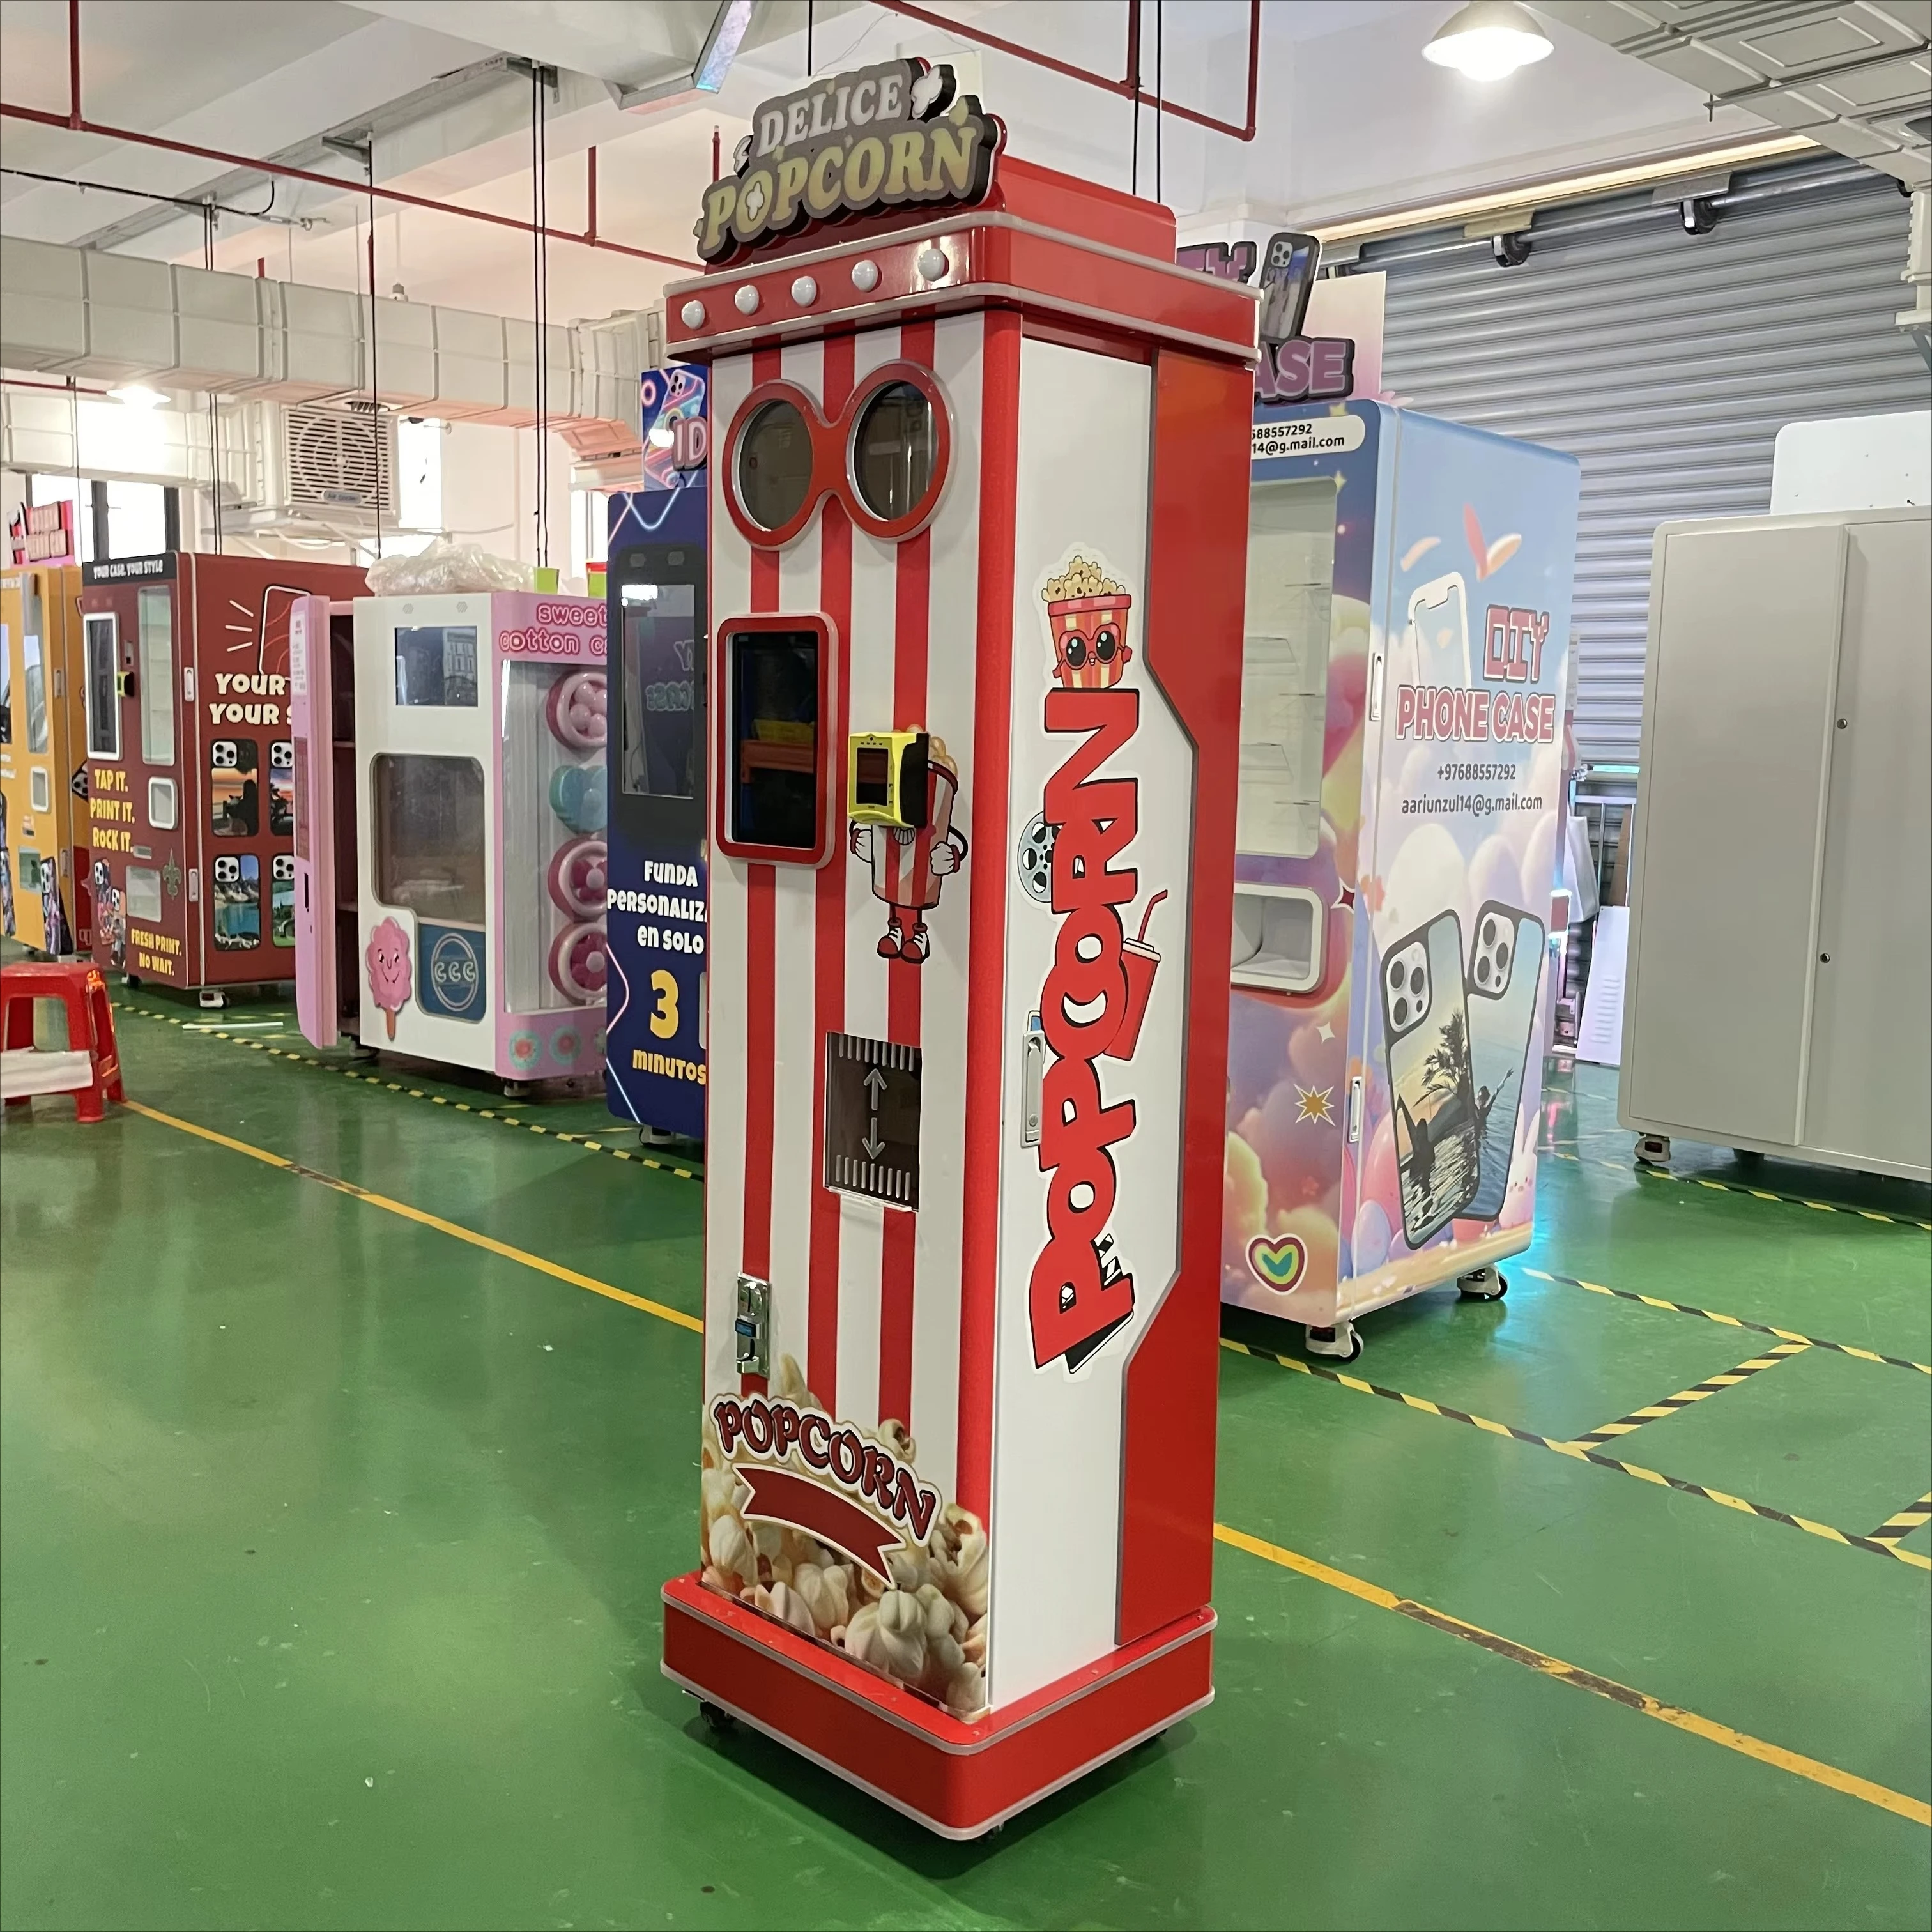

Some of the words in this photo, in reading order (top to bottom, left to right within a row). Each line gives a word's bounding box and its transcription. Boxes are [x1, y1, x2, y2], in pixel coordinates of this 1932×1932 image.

[756, 74, 903, 157] DELICE
[702, 126, 977, 250] POPCORN
[536, 603, 607, 627] sweet
[499, 627, 580, 656] cotton
[1483, 604, 1550, 684] DIY
[215, 673, 286, 695] YOUR
[208, 703, 280, 725] YOUR
[1395, 685, 1491, 742] PHONE
[1491, 691, 1556, 744] CASE
[94, 769, 114, 791] TAP
[116, 770, 128, 792] IT.
[1438, 763, 1516, 781] +97688557292
[90, 797, 120, 821] PRINT
[122, 802, 135, 824] IT.
[1402, 792, 1542, 817] aariunzul14@g.mail.com
[93, 827, 119, 851] ROCK
[121, 831, 133, 853] IT.
[644, 860, 698, 887] FUNDA
[607, 889, 707, 923] PERSONALIZ
[131, 928, 154, 949] FRESH
[155, 934, 182, 956] PRINT.
[663, 930, 705, 954] SOLO
[139, 951, 151, 969] NO
[151, 955, 174, 976] WAIT.
[650, 969, 679, 1039] 3
[1029, 687, 1140, 1368] POPCORN
[713, 1399, 937, 1542] POPCORN
